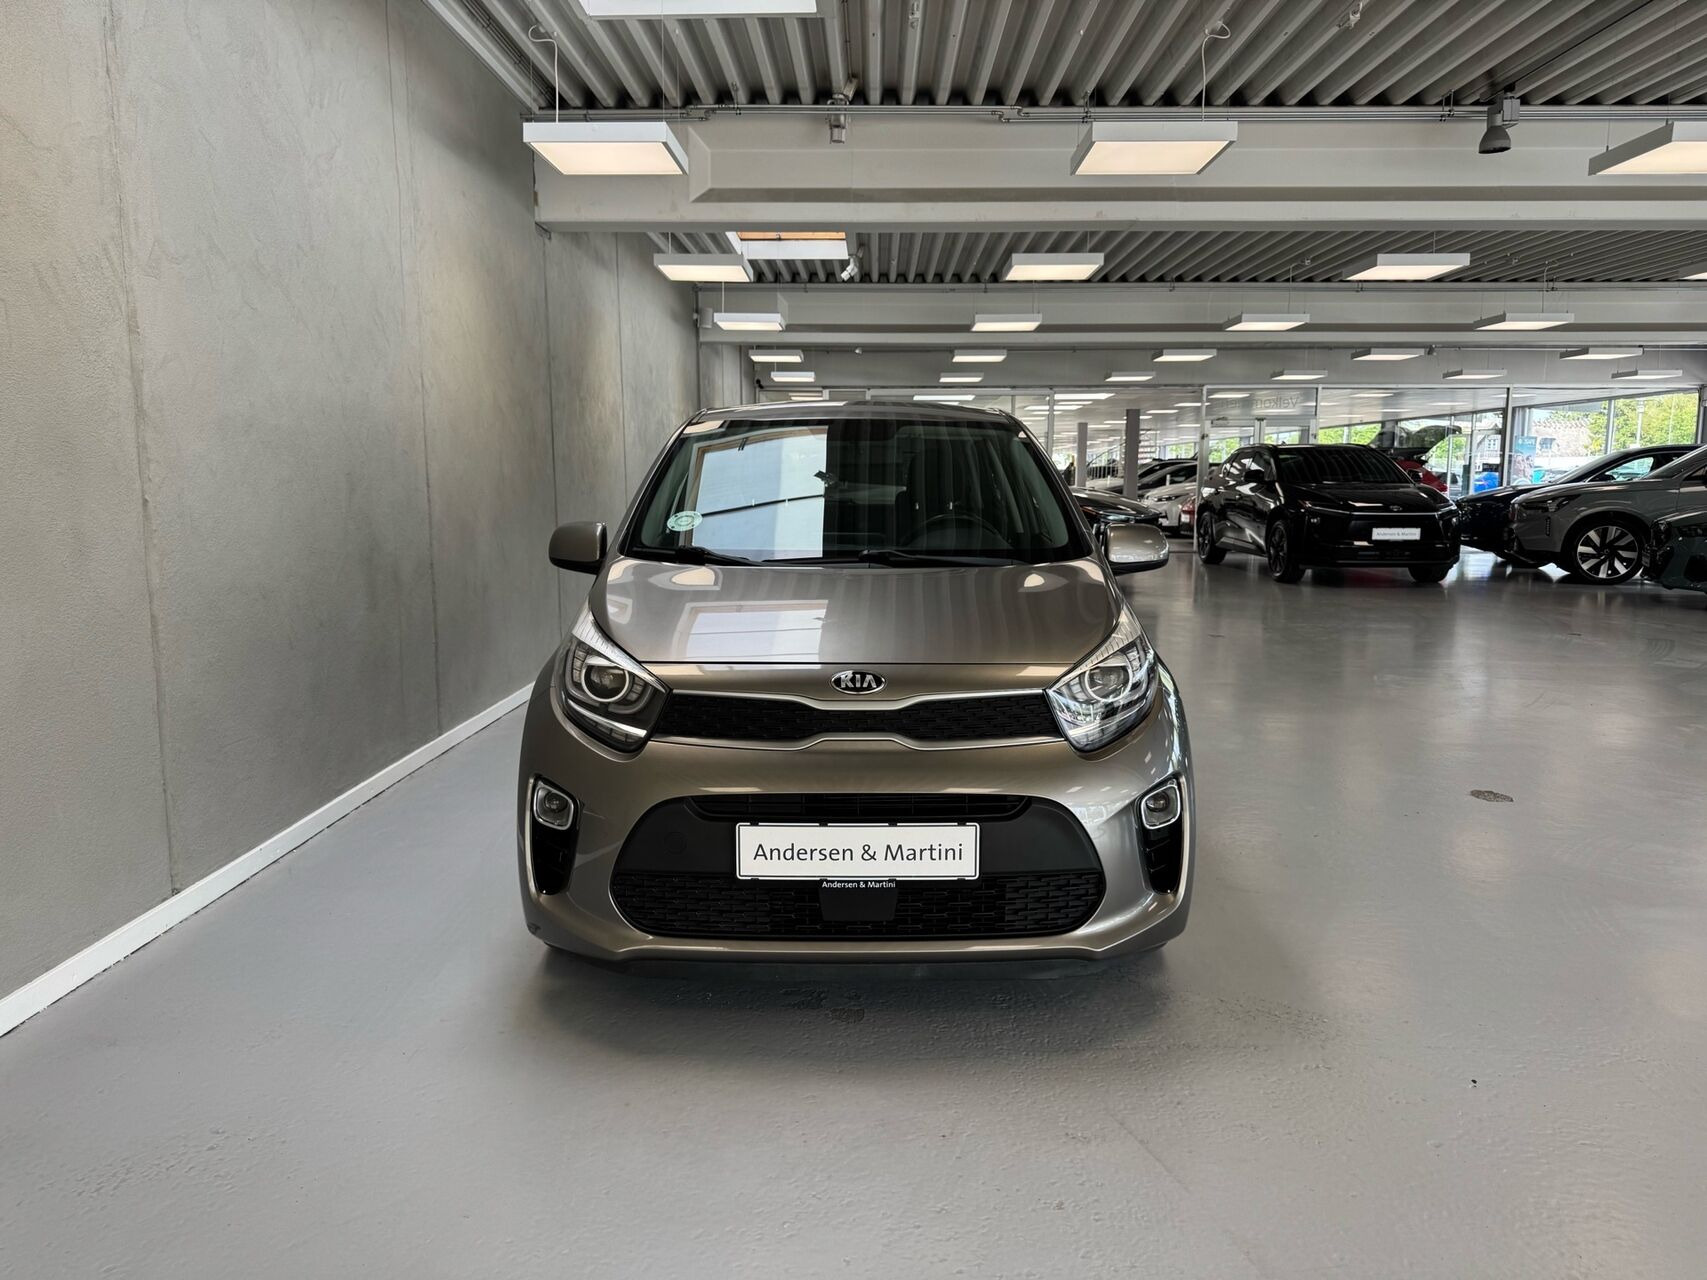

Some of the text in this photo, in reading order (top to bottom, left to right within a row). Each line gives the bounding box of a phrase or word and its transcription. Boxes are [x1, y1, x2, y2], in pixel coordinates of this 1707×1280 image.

[839, 672, 878, 689] KIA
[753, 842, 963, 862] Andersen & Martini
[821, 880, 896, 889] Andersen & Martini
